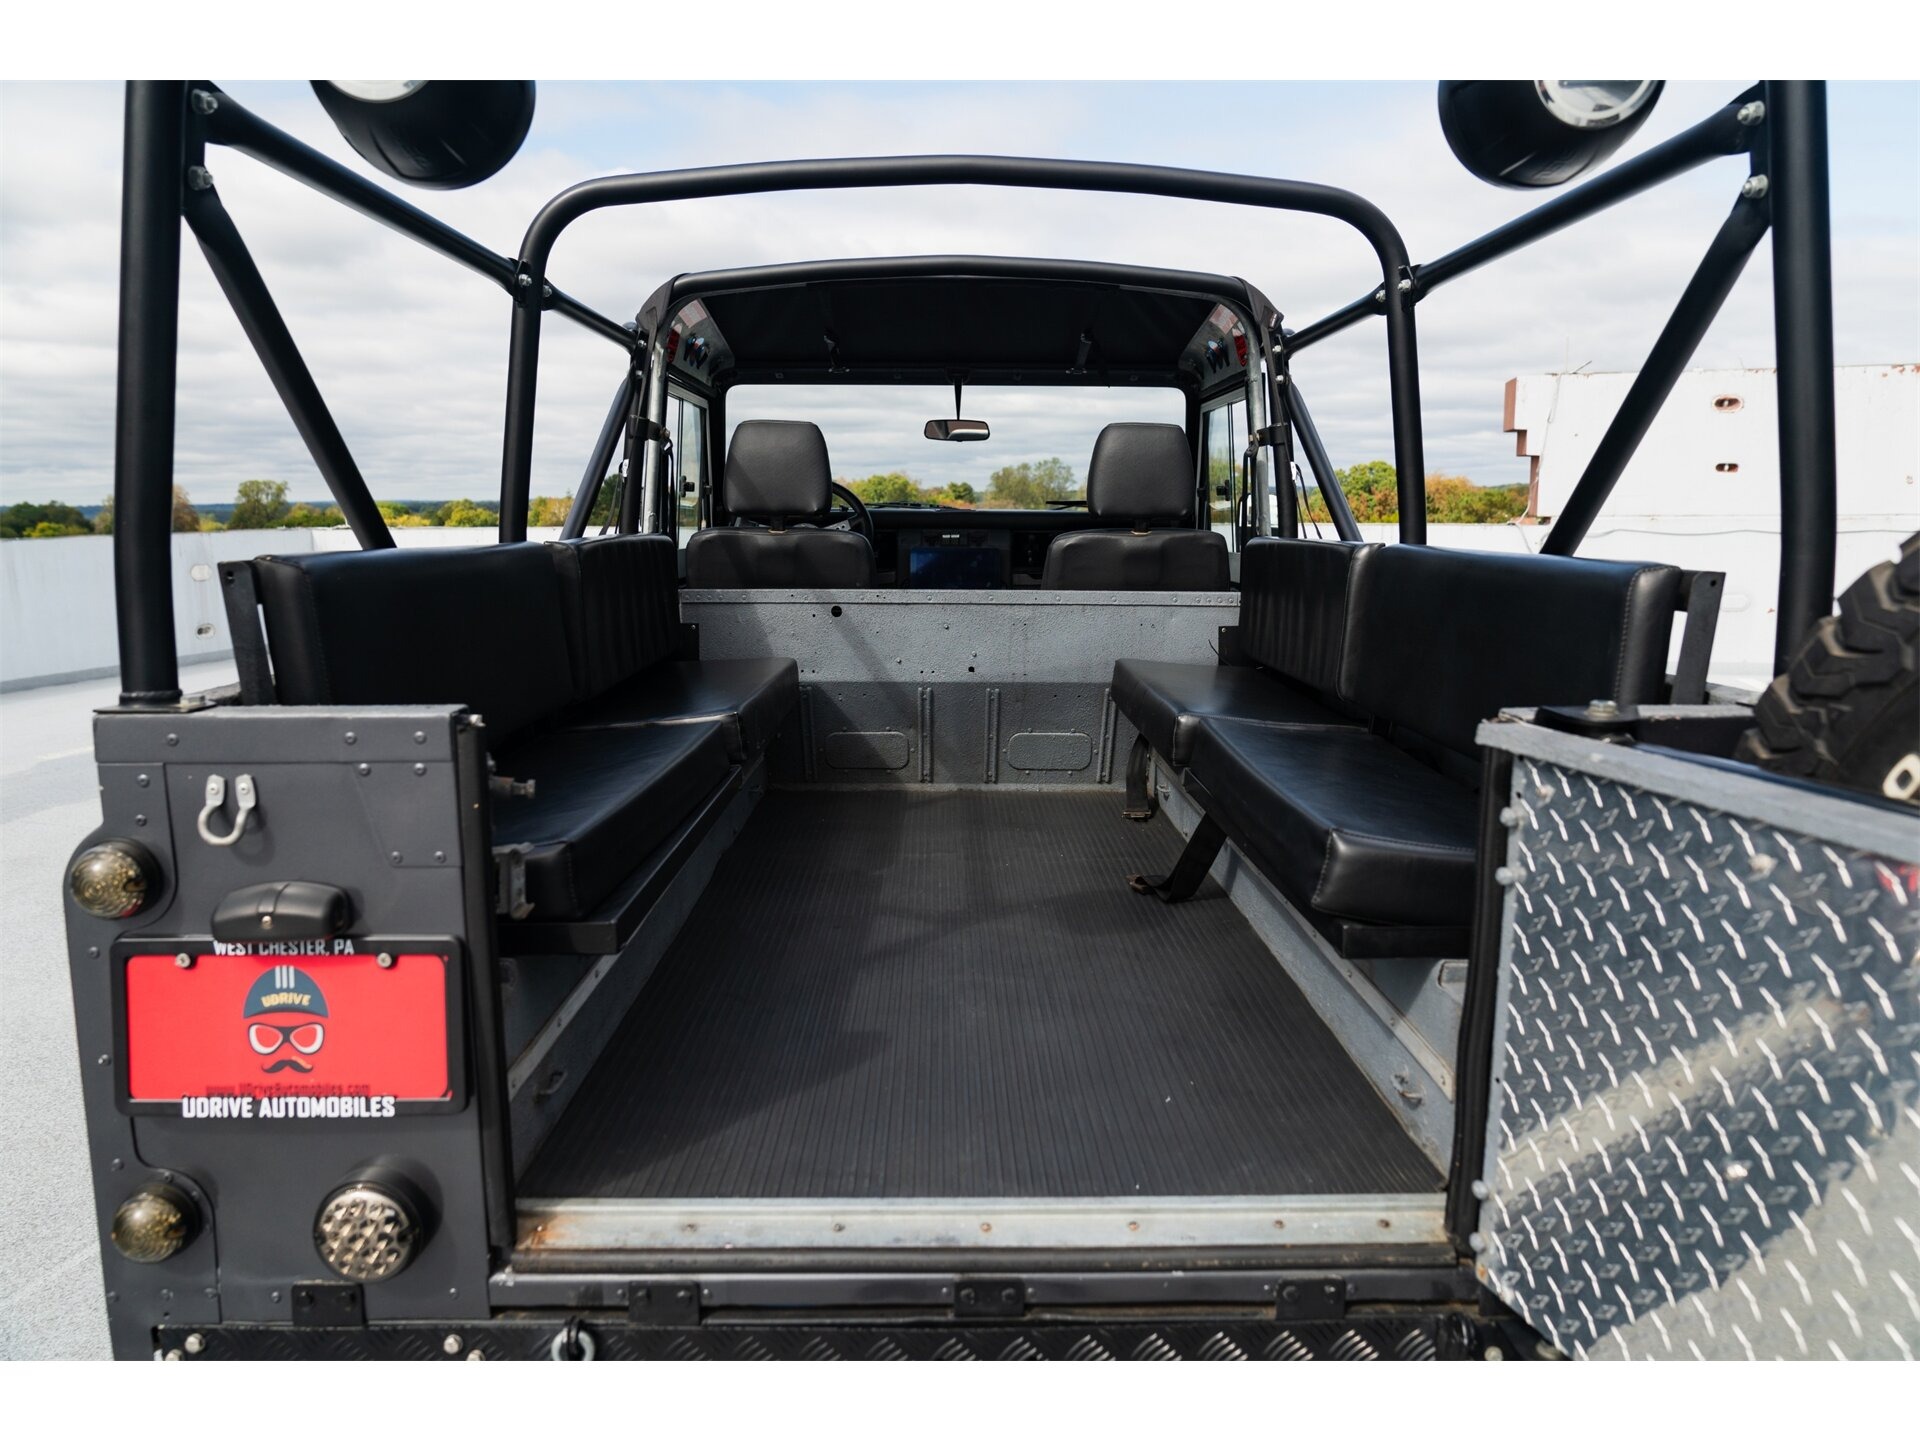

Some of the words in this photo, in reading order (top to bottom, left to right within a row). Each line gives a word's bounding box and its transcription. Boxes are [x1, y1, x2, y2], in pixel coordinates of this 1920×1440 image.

[213, 939, 252, 956] WEST
[259, 939, 330, 956] CHESTER,
[333, 938, 355, 956] PA
[261, 991, 311, 1008] UDRIVE
[181, 1096, 253, 1119] UDRIVE
[258, 1096, 396, 1119] AUTOMOBILES
